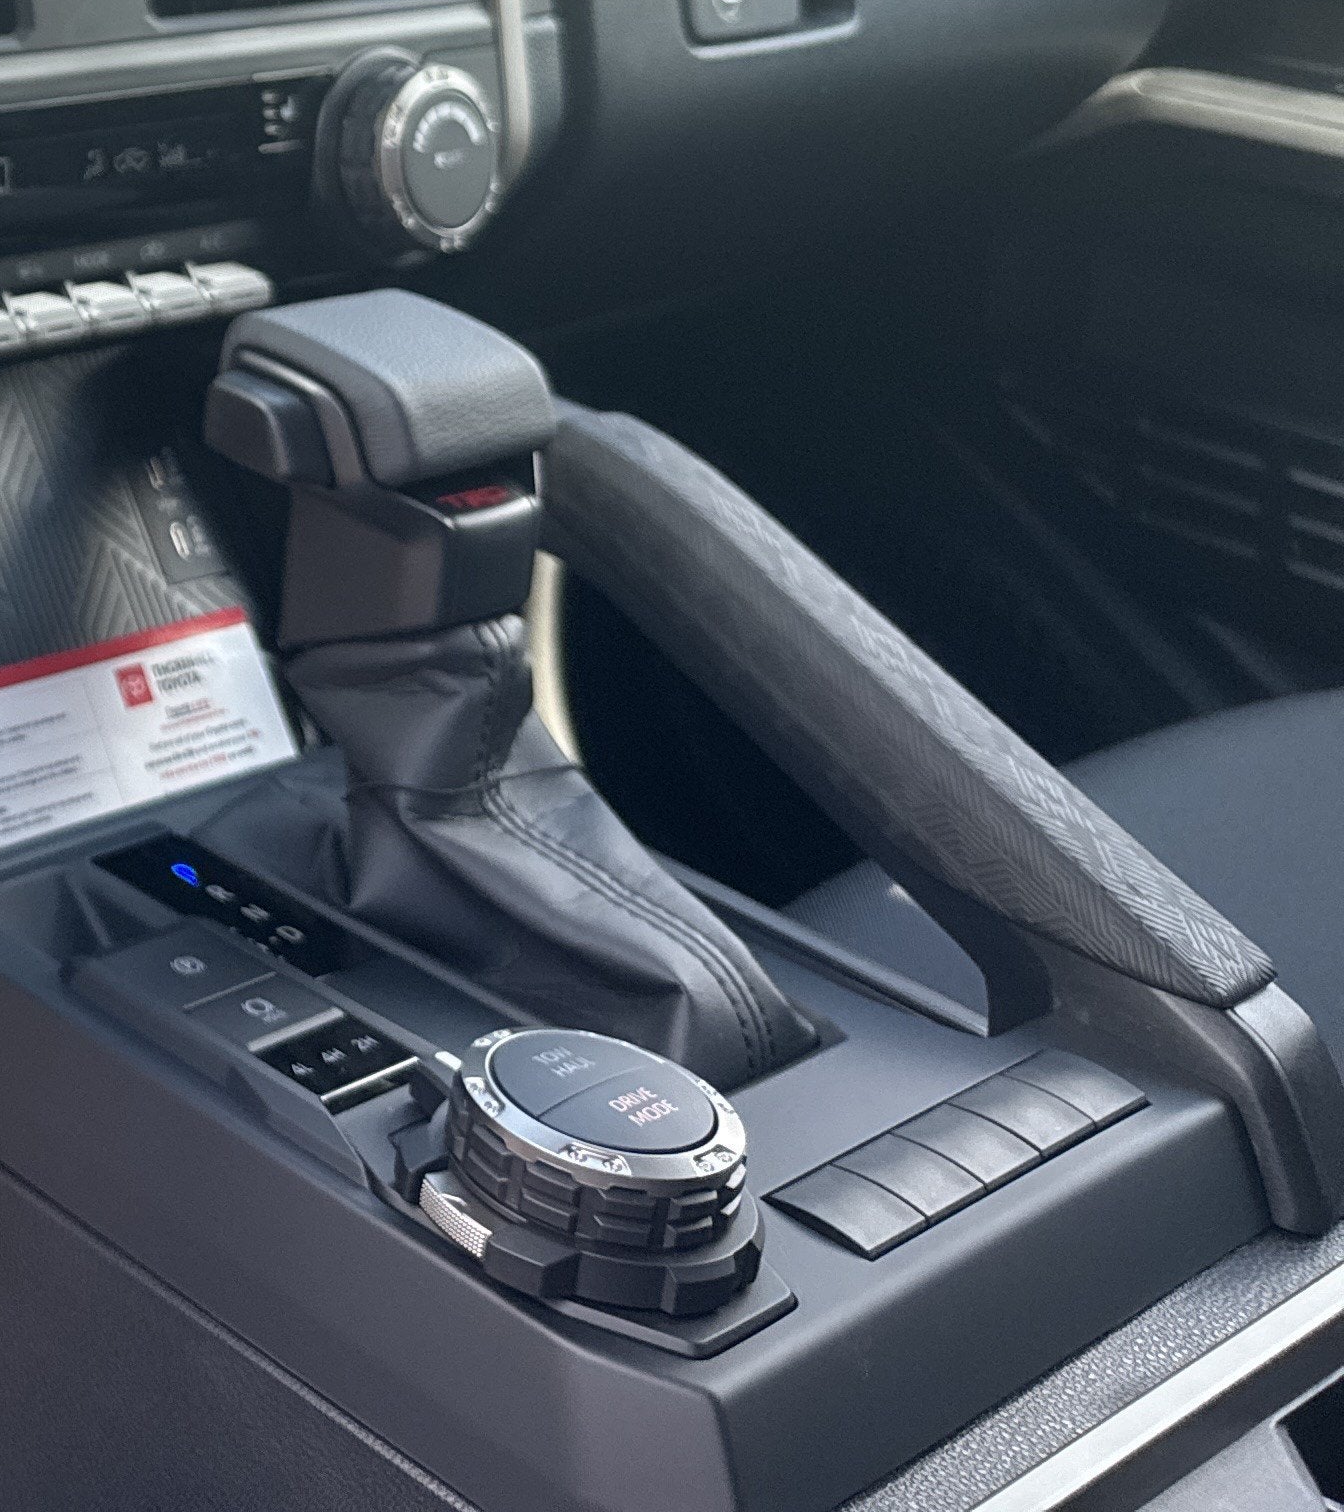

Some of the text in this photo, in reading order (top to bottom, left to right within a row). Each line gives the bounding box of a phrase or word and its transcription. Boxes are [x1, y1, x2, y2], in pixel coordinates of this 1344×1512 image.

[351, 1035, 380, 1052] 2H
[321, 1047, 347, 1064] 4H
[532, 1046, 573, 1066] TOW
[551, 1056, 596, 1077] HAUL
[608, 1086, 659, 1113] DRIVE
[628, 1099, 679, 1127] MODE
